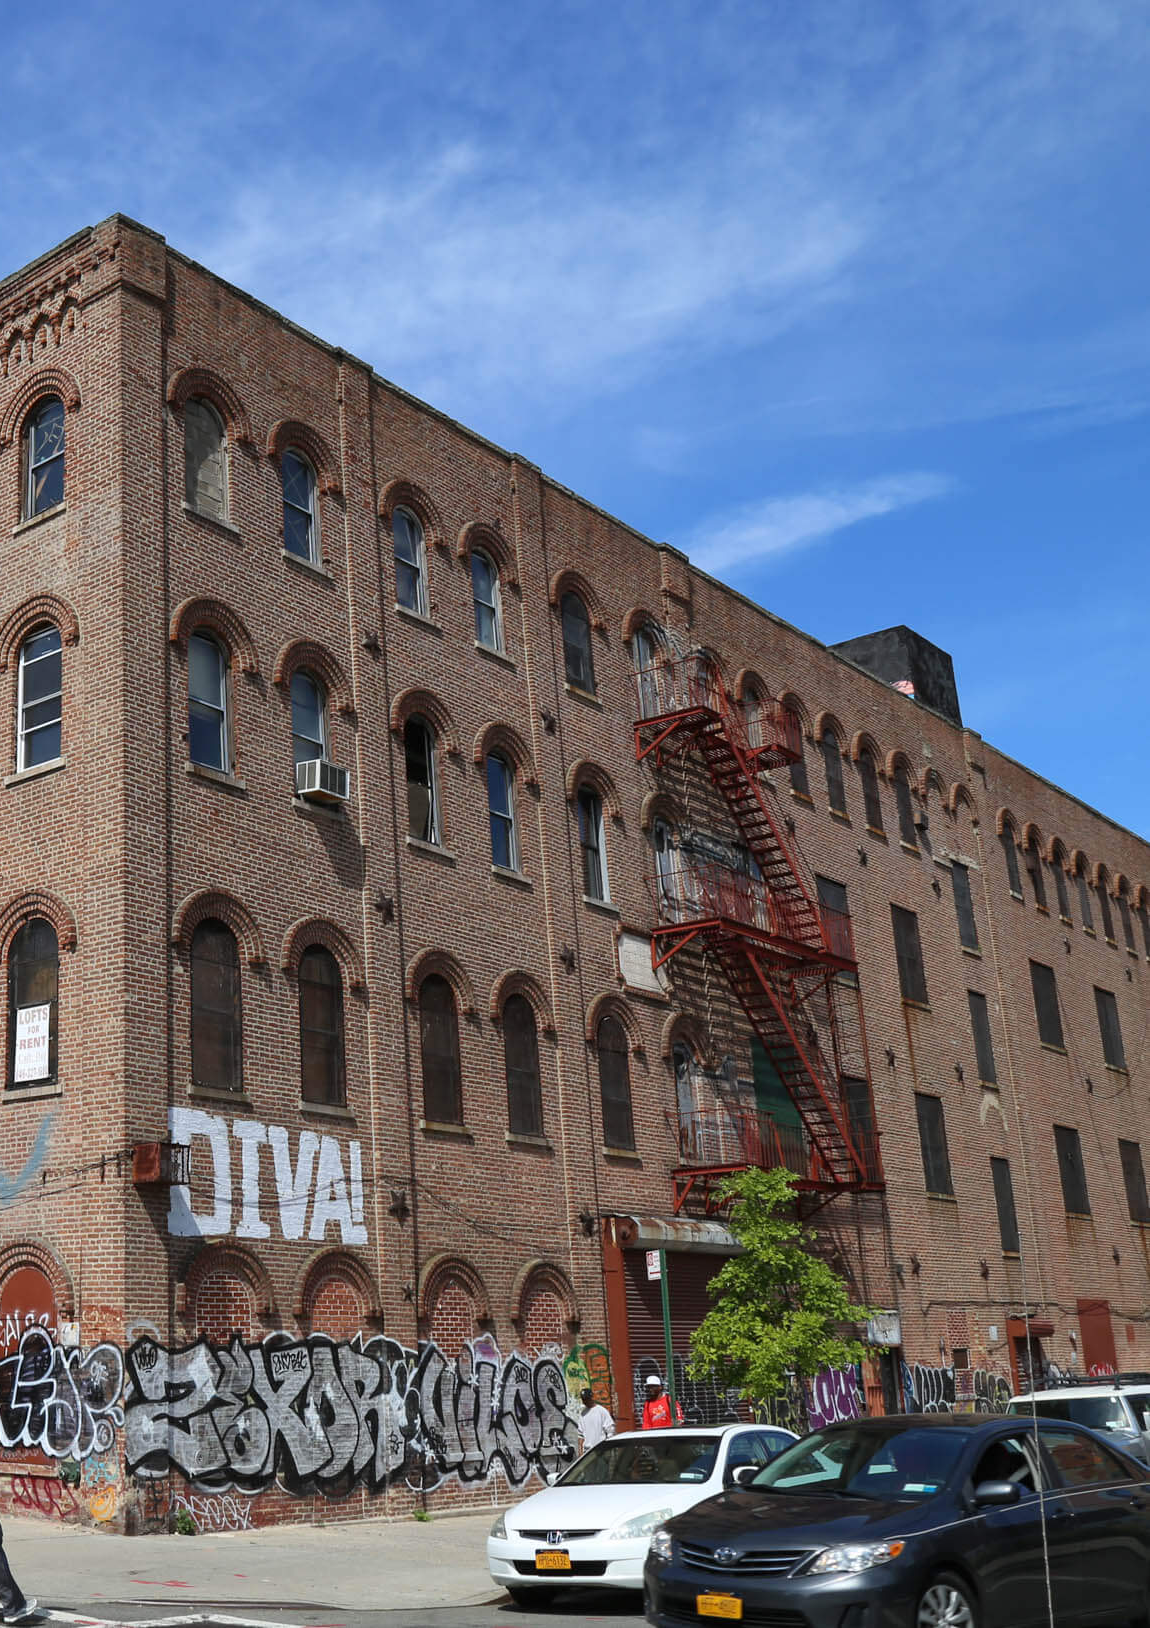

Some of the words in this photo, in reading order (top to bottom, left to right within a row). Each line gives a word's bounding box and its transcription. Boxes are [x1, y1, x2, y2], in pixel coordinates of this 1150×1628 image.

[19, 1006, 48, 1025] LOFTS
[19, 1036, 47, 1051] RENT
[167, 1106, 369, 1246] DIVA!
